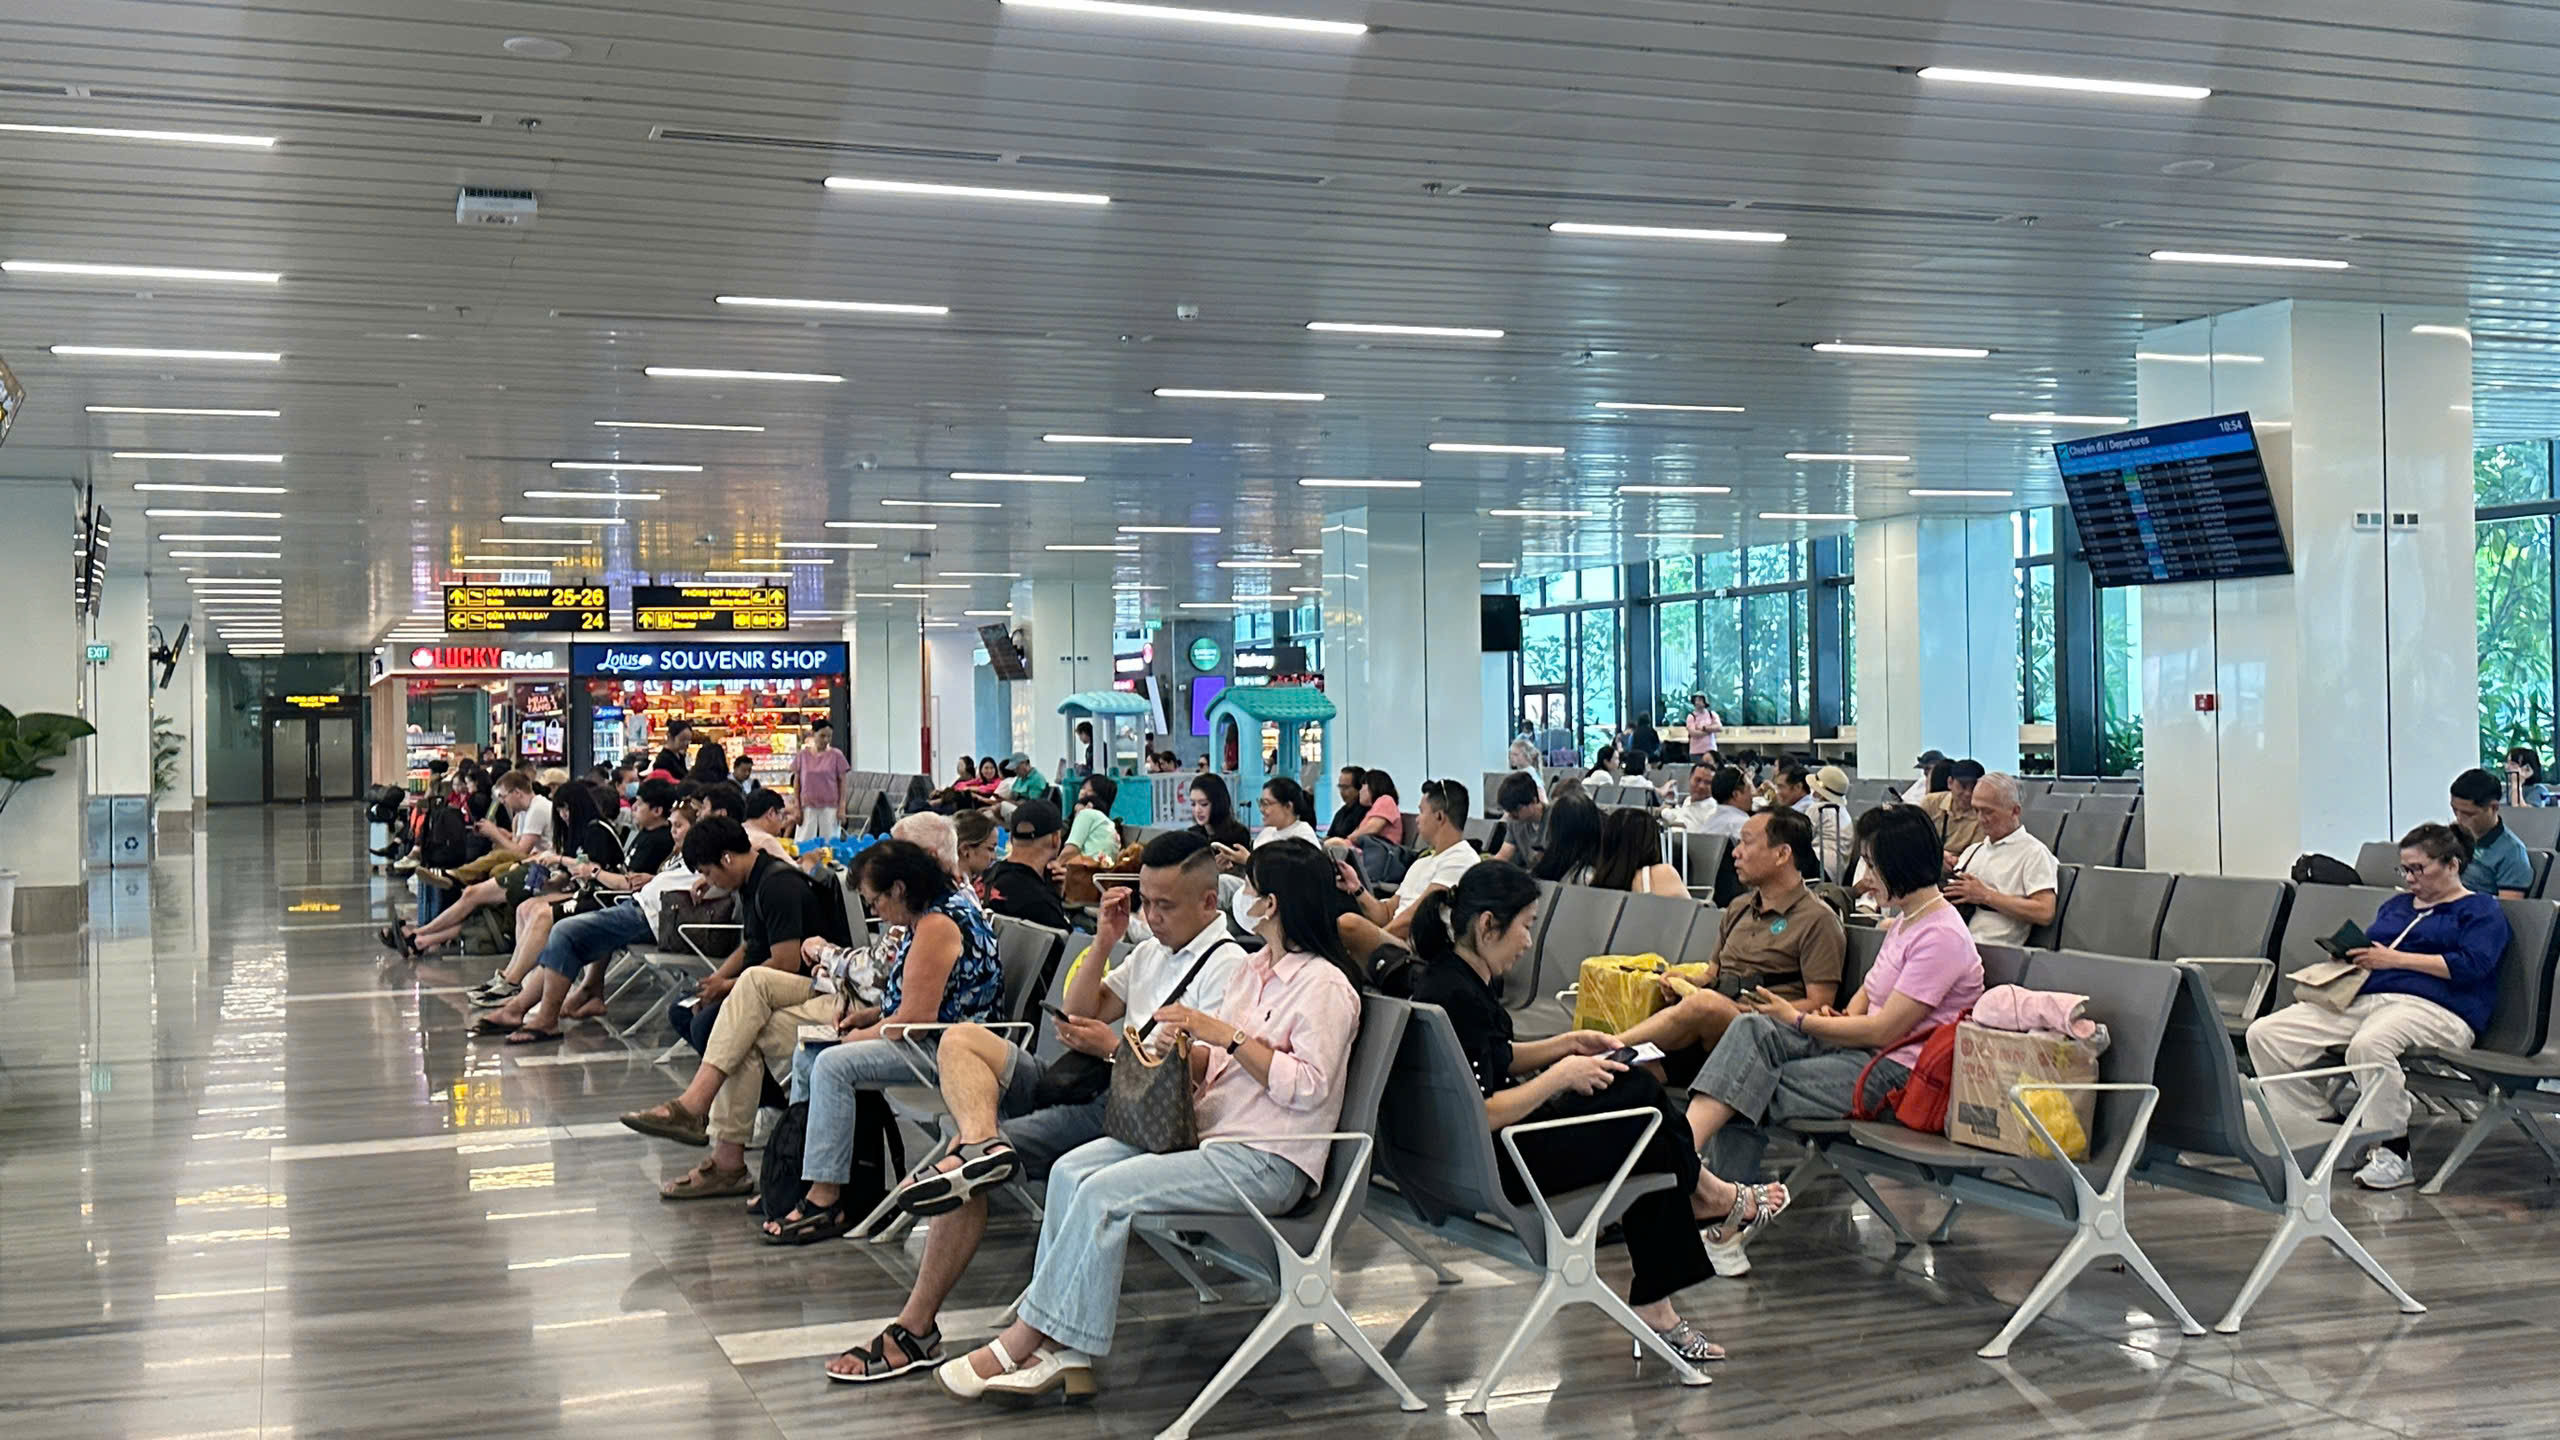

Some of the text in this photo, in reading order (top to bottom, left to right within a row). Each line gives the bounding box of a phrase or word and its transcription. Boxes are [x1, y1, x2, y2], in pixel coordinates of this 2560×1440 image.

[2219, 419, 2244, 433] 10:54
[2109, 436, 2150, 450] Departures
[551, 588, 605, 606] 25-26
[581, 612, 604, 630] 24
[87, 646, 108, 658] EXIT
[433, 647, 554, 669] LUCKY Retail
[596, 648, 640, 674] Lotus
[659, 650, 828, 671] SOUVENIR SHOP
